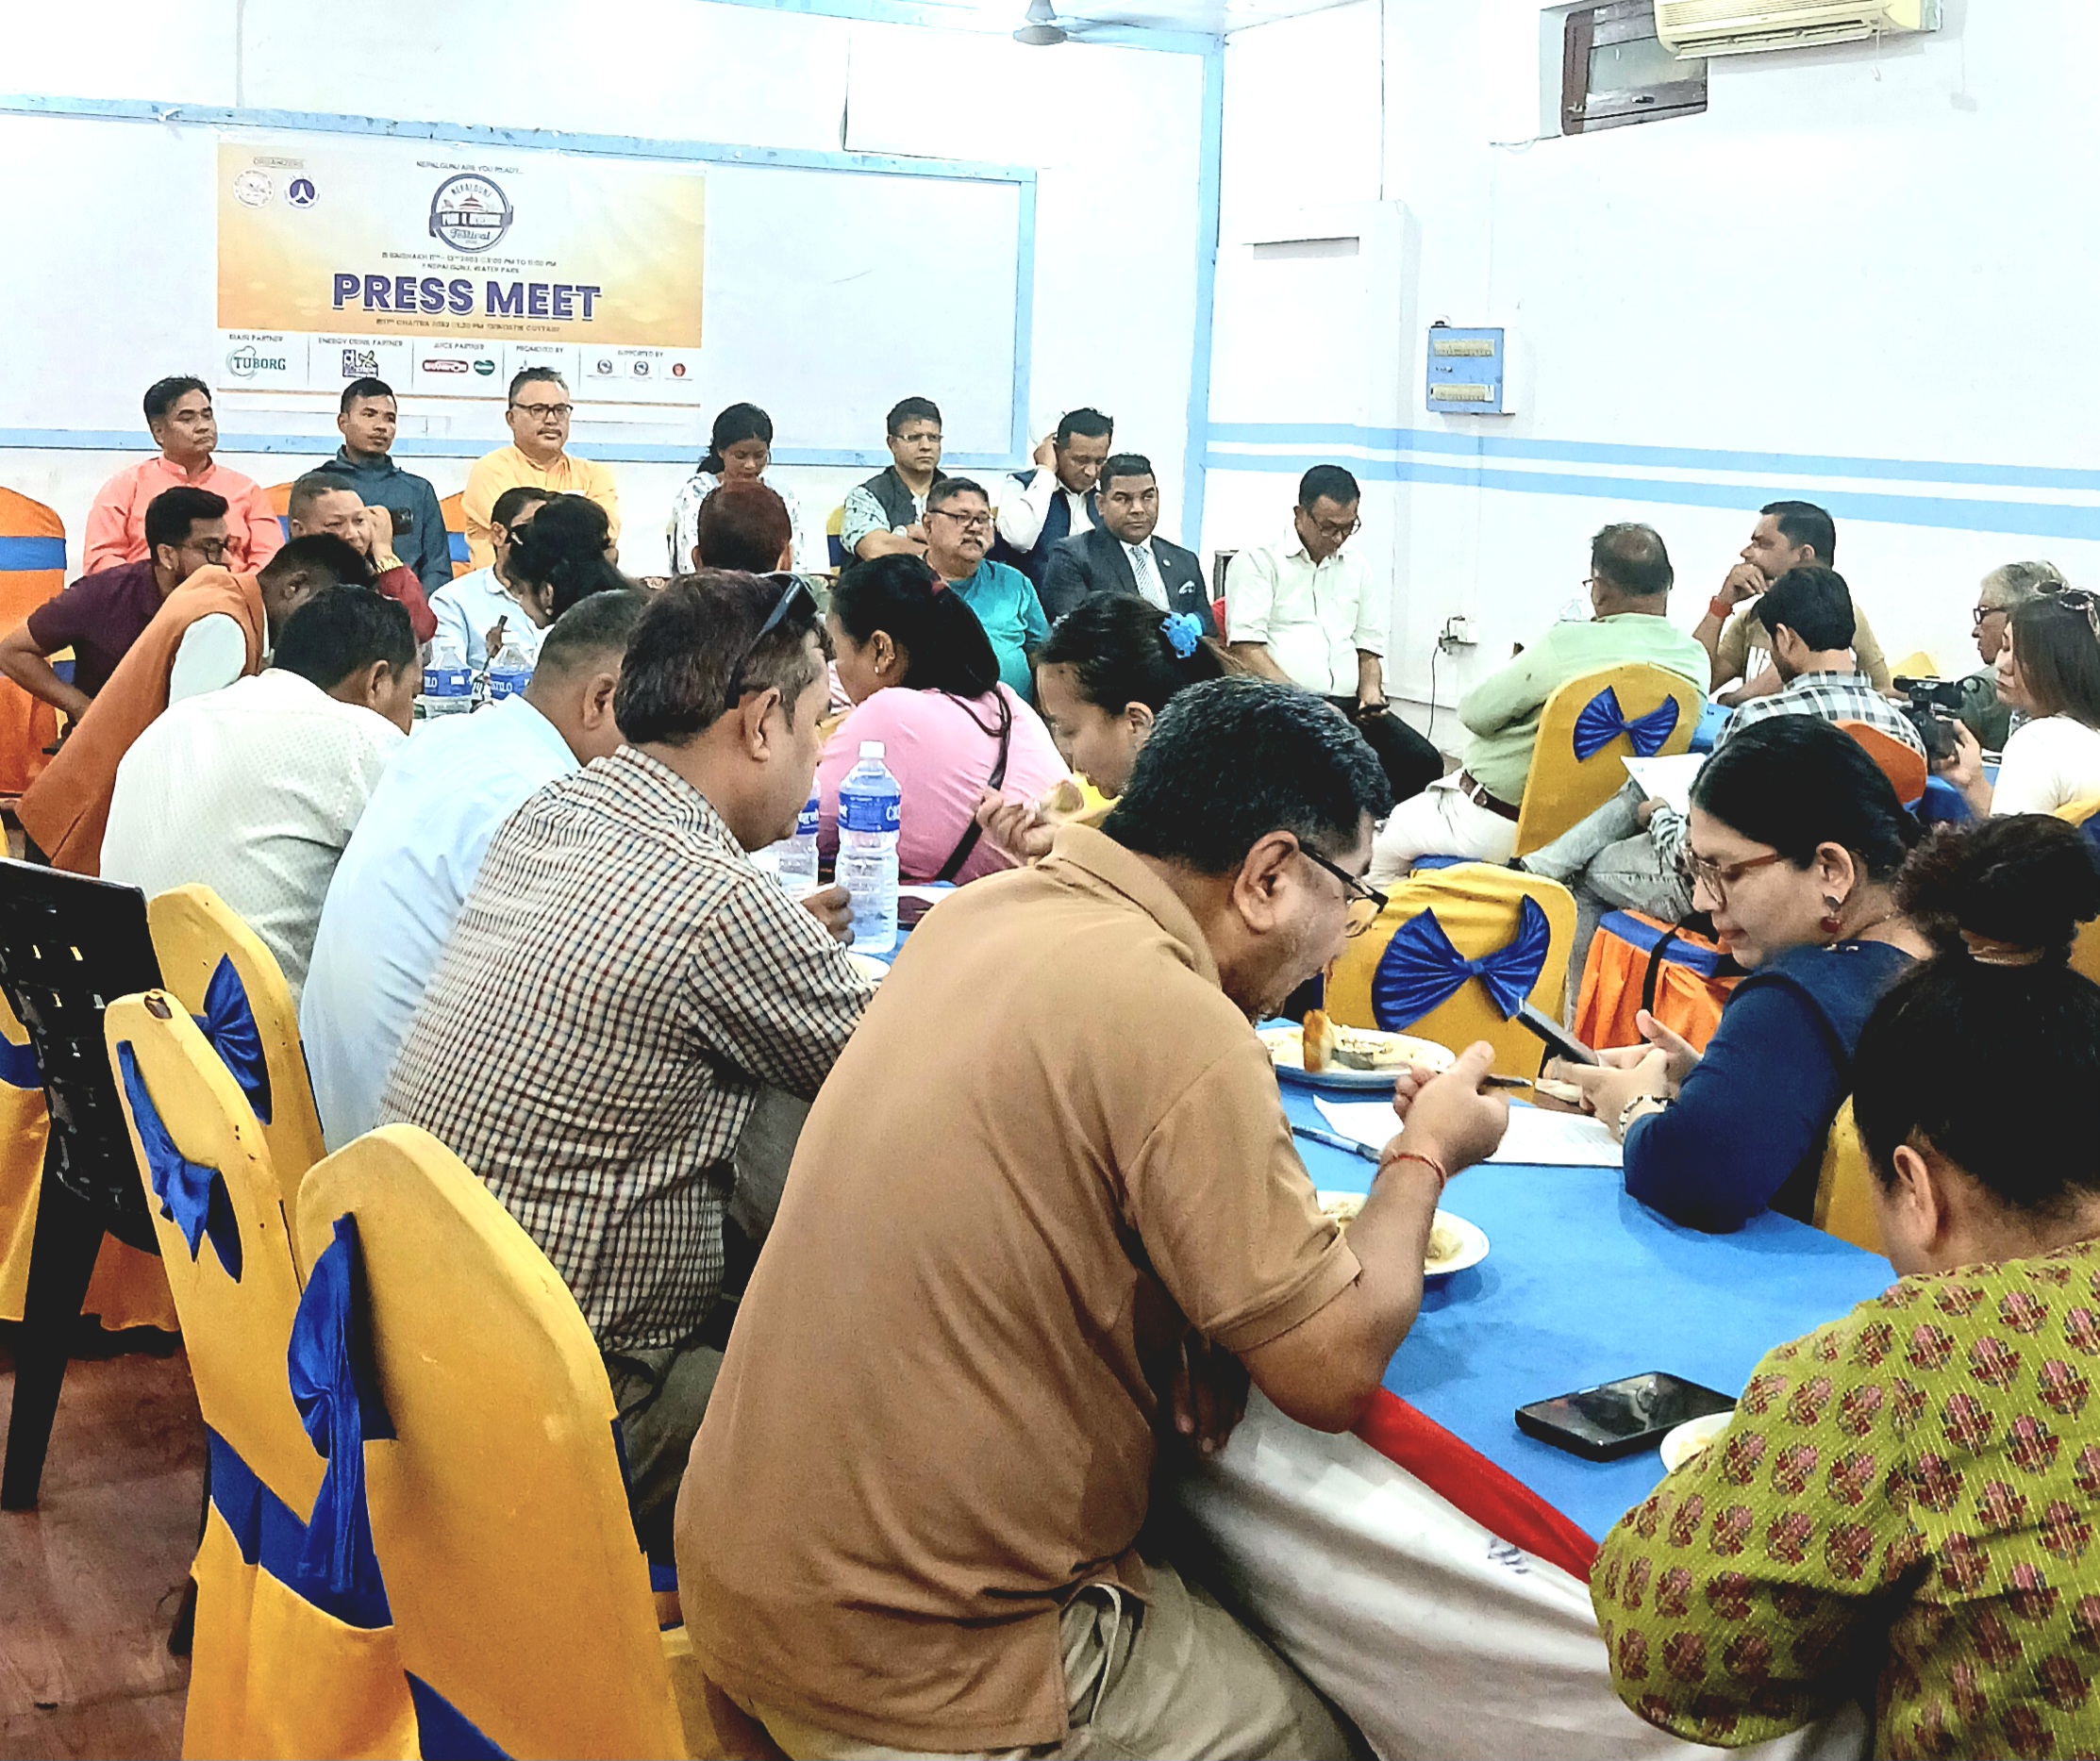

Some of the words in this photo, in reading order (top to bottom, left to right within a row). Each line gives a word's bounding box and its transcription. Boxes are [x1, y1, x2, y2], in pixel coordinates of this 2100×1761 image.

[333, 273, 474, 315] PRESS
[485, 280, 602, 322] MEET
[233, 356, 286, 371] TUBORG
